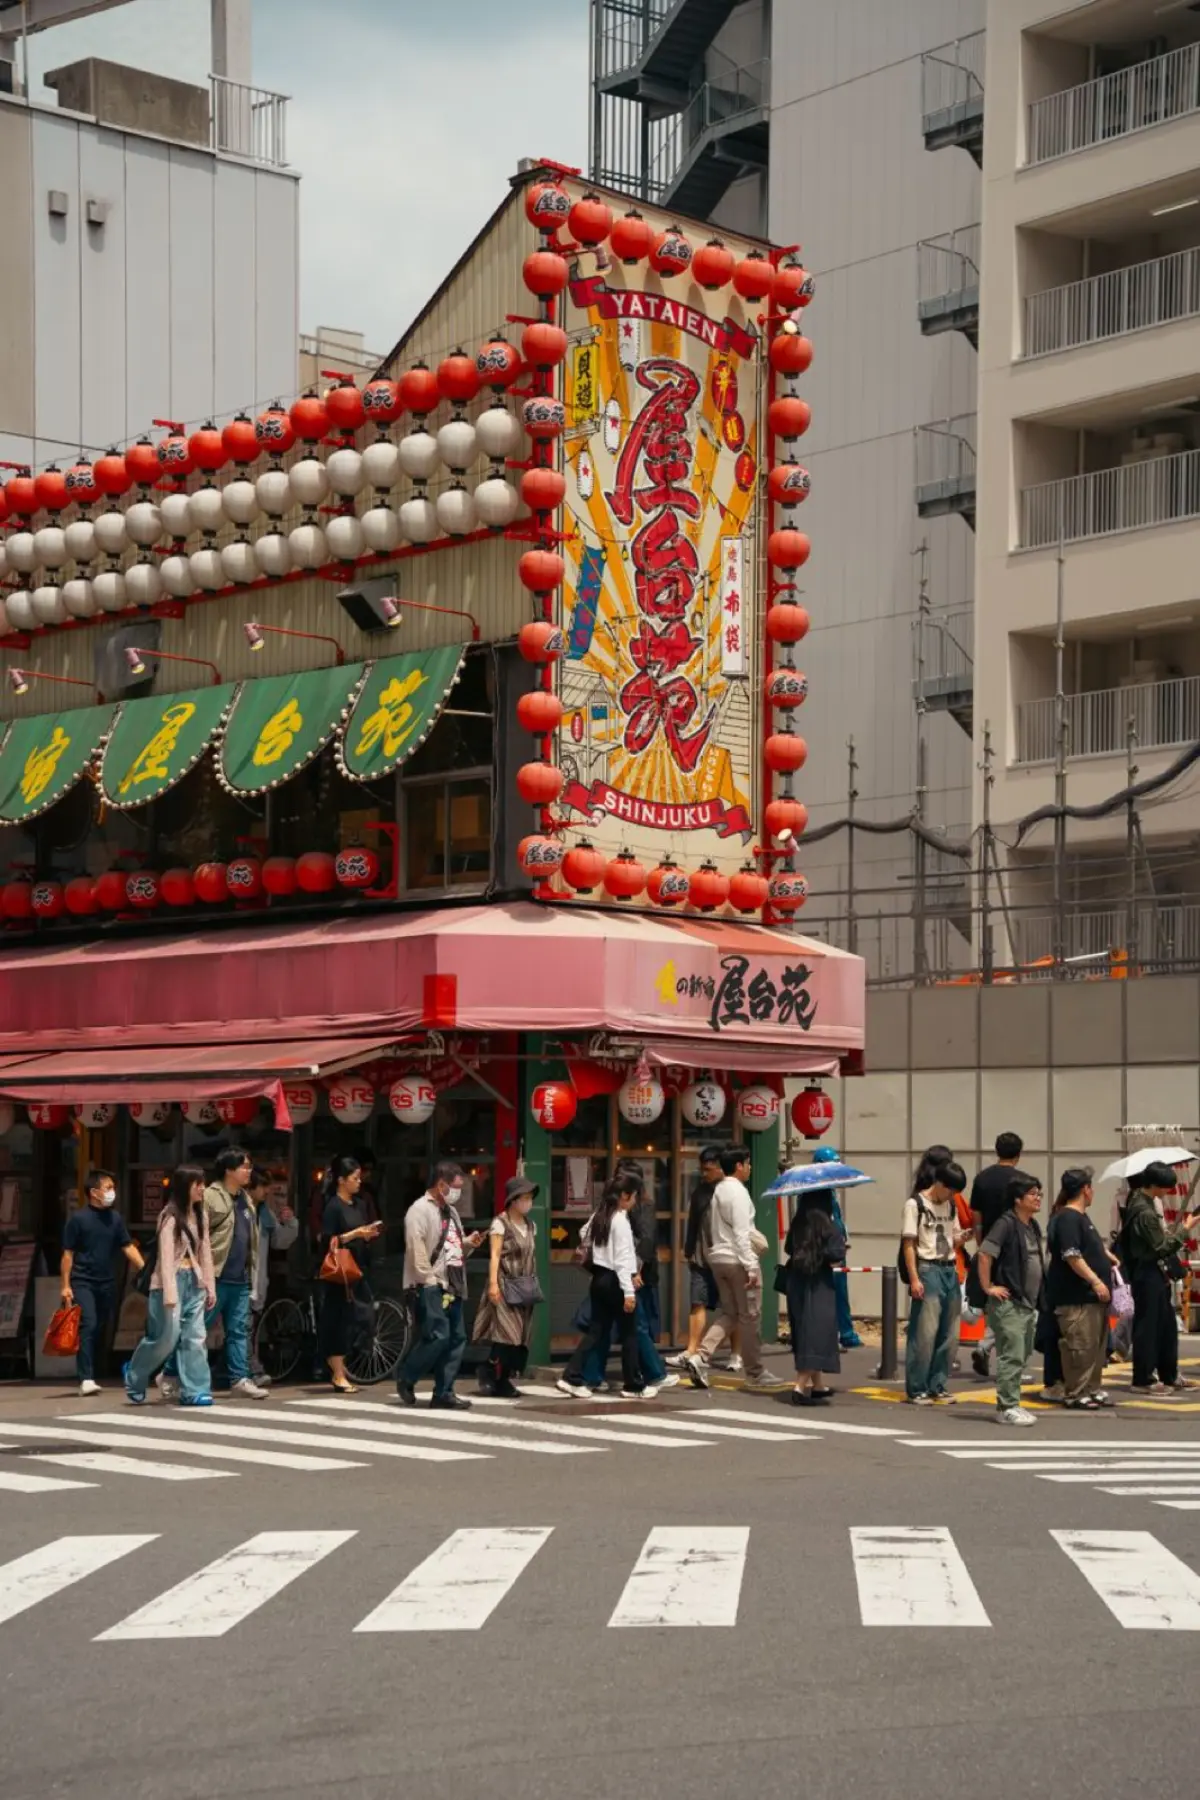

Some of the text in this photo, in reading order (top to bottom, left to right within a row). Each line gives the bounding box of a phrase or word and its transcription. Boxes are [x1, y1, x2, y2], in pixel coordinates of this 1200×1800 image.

[610, 294, 718, 347] YATAIEN
[605, 359, 717, 772] 屋台苑
[604, 790, 711, 826] SHINJUKU
[742, 1104, 767, 1117] RS
